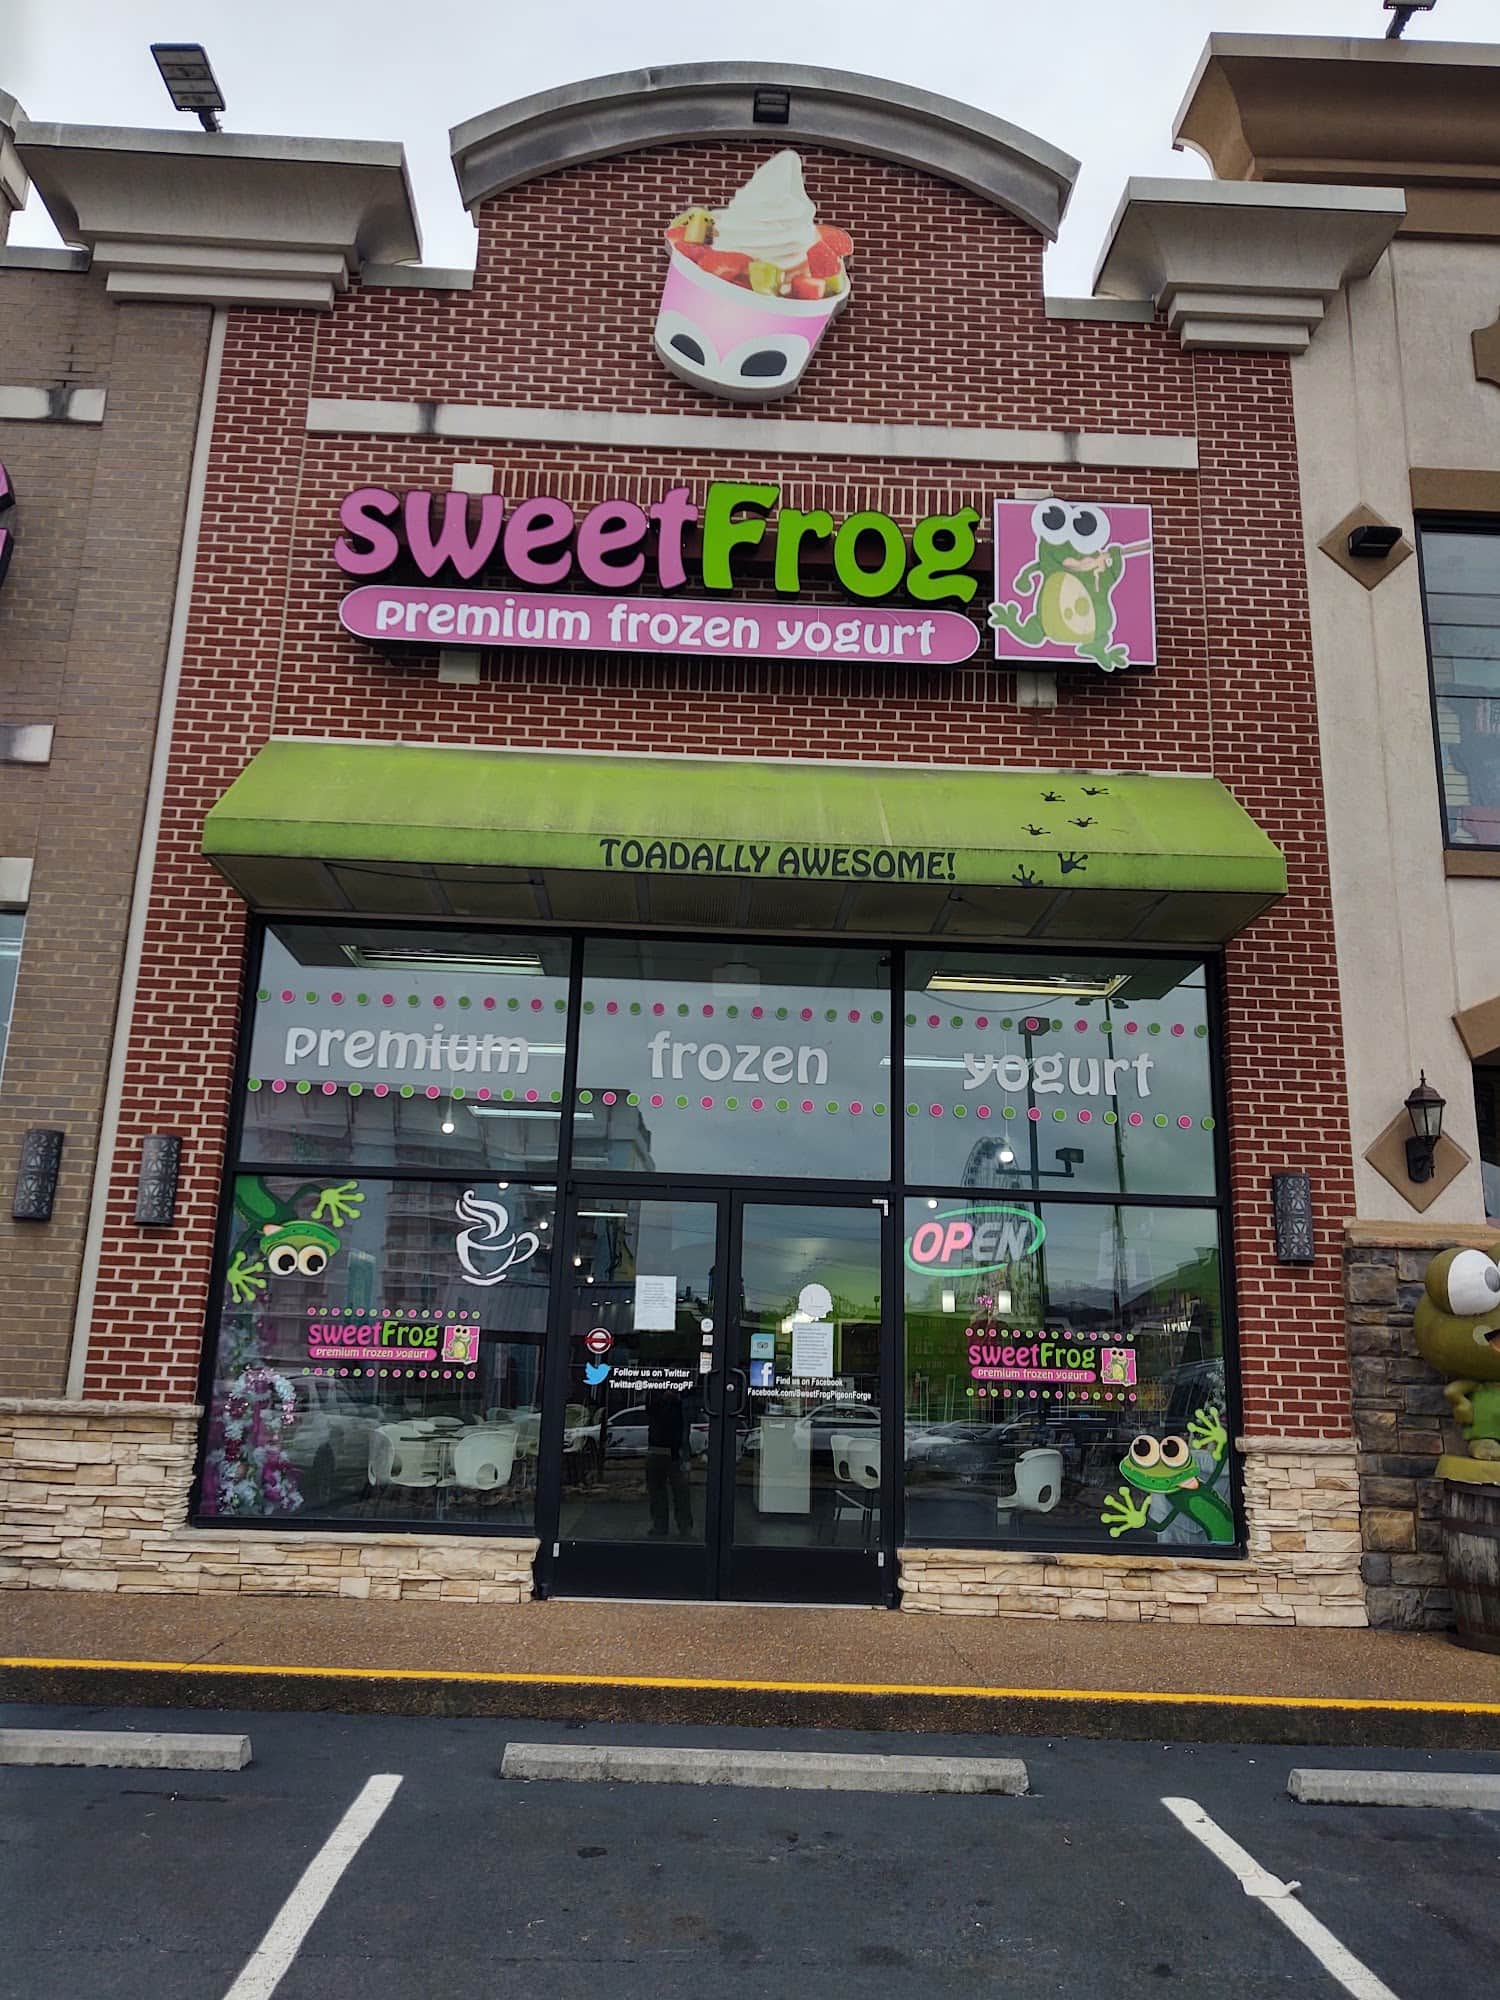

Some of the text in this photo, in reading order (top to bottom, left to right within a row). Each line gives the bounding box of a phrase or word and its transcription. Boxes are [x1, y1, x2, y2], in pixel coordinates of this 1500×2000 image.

[334, 481, 981, 603] sweetFrog
[375, 598, 936, 656] premium frozen yogurt
[600, 838, 955, 881] TOADALLY AWESOME!
[284, 1023, 1155, 1098] premium frozen yogurt
[911, 1221, 1030, 1263] OPEN
[308, 1320, 439, 1347] sweetFrog
[316, 1347, 429, 1360] premium frozen yogurt
[968, 1343, 1096, 1369] sweetFrog
[613, 1367, 690, 1378] Follow us on Twitter
[776, 1376, 790, 1385] Find
[801, 1378, 810, 1386] on
[811, 1377, 843, 1386] Facebook
[978, 1367, 1089, 1382] premium frozen yogurt
